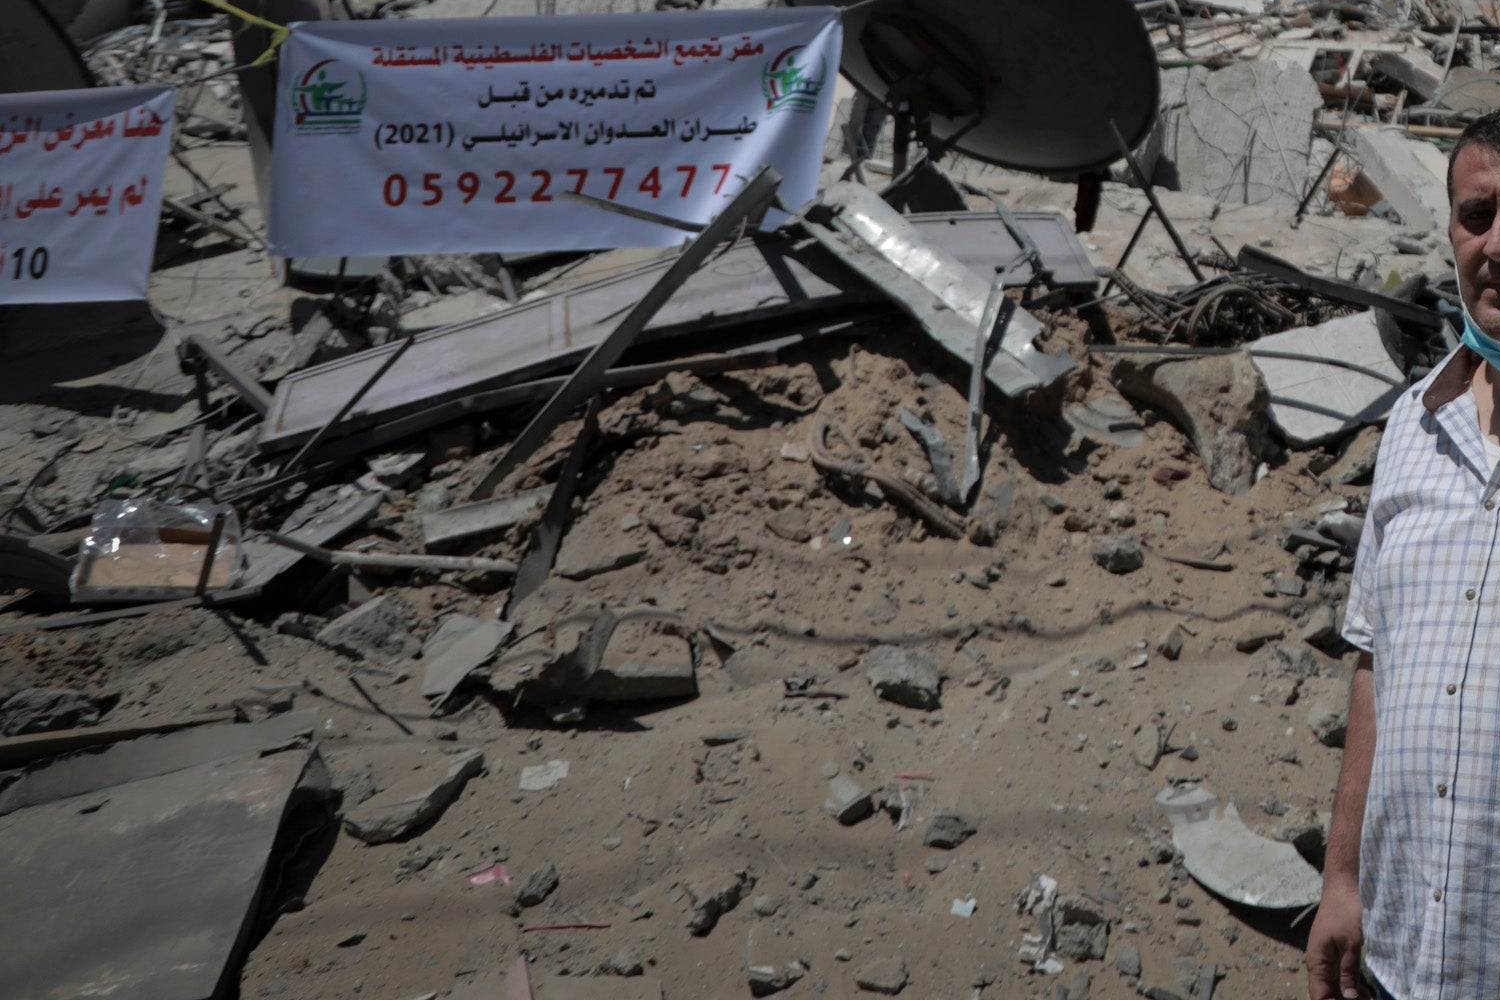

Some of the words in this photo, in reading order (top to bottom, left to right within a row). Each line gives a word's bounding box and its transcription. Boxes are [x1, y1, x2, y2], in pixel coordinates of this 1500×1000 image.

[371, 46, 448, 67] المستقلة
[452, 44, 562, 70] الفلسطينية
[567, 38, 670, 66] الشخصيات
[675, 39, 723, 66] تجمع
[729, 38, 765, 60] مقر
[477, 82, 531, 110] قبل
[536, 82, 563, 107] من
[570, 79, 630, 105] تدميره
[634, 81, 656, 101] تم
[43, 112, 115, 151] معرض
[375, 121, 456, 149] (2021)
[585, 119, 675, 146] العدوان
[679, 117, 759, 143] طيران
[16, 179, 64, 219] على
[118, 175, 148, 215] لم
[382, 163, 733, 208] 0592277477
[68, 184, 113, 216] يمر
[12, 246, 49, 280] 10
